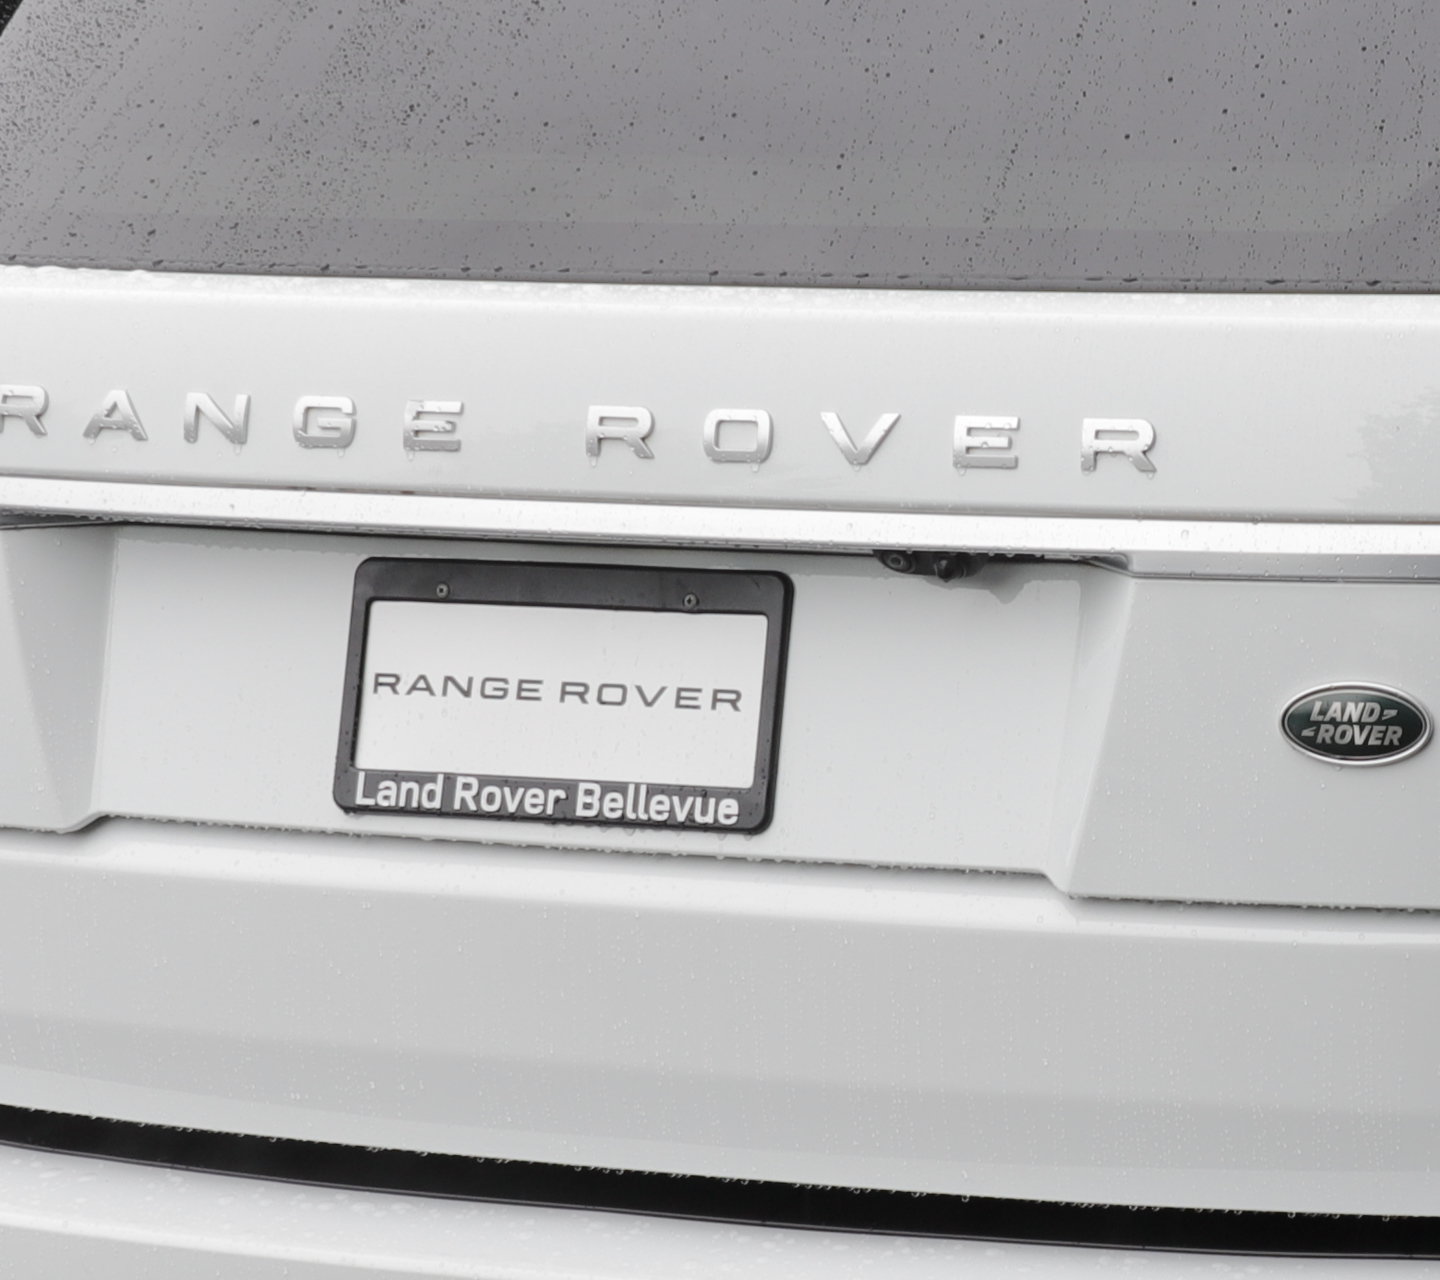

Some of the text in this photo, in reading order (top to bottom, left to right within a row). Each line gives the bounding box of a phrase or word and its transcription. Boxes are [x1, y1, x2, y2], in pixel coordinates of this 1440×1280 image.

[585, 405, 1157, 473] ROVER
[373, 672, 743, 712] RANGE ROVER
[1310, 700, 1381, 723] LAND
[1315, 723, 1403, 746] ROVER
[354, 770, 739, 825] Land Rover Bellevue
